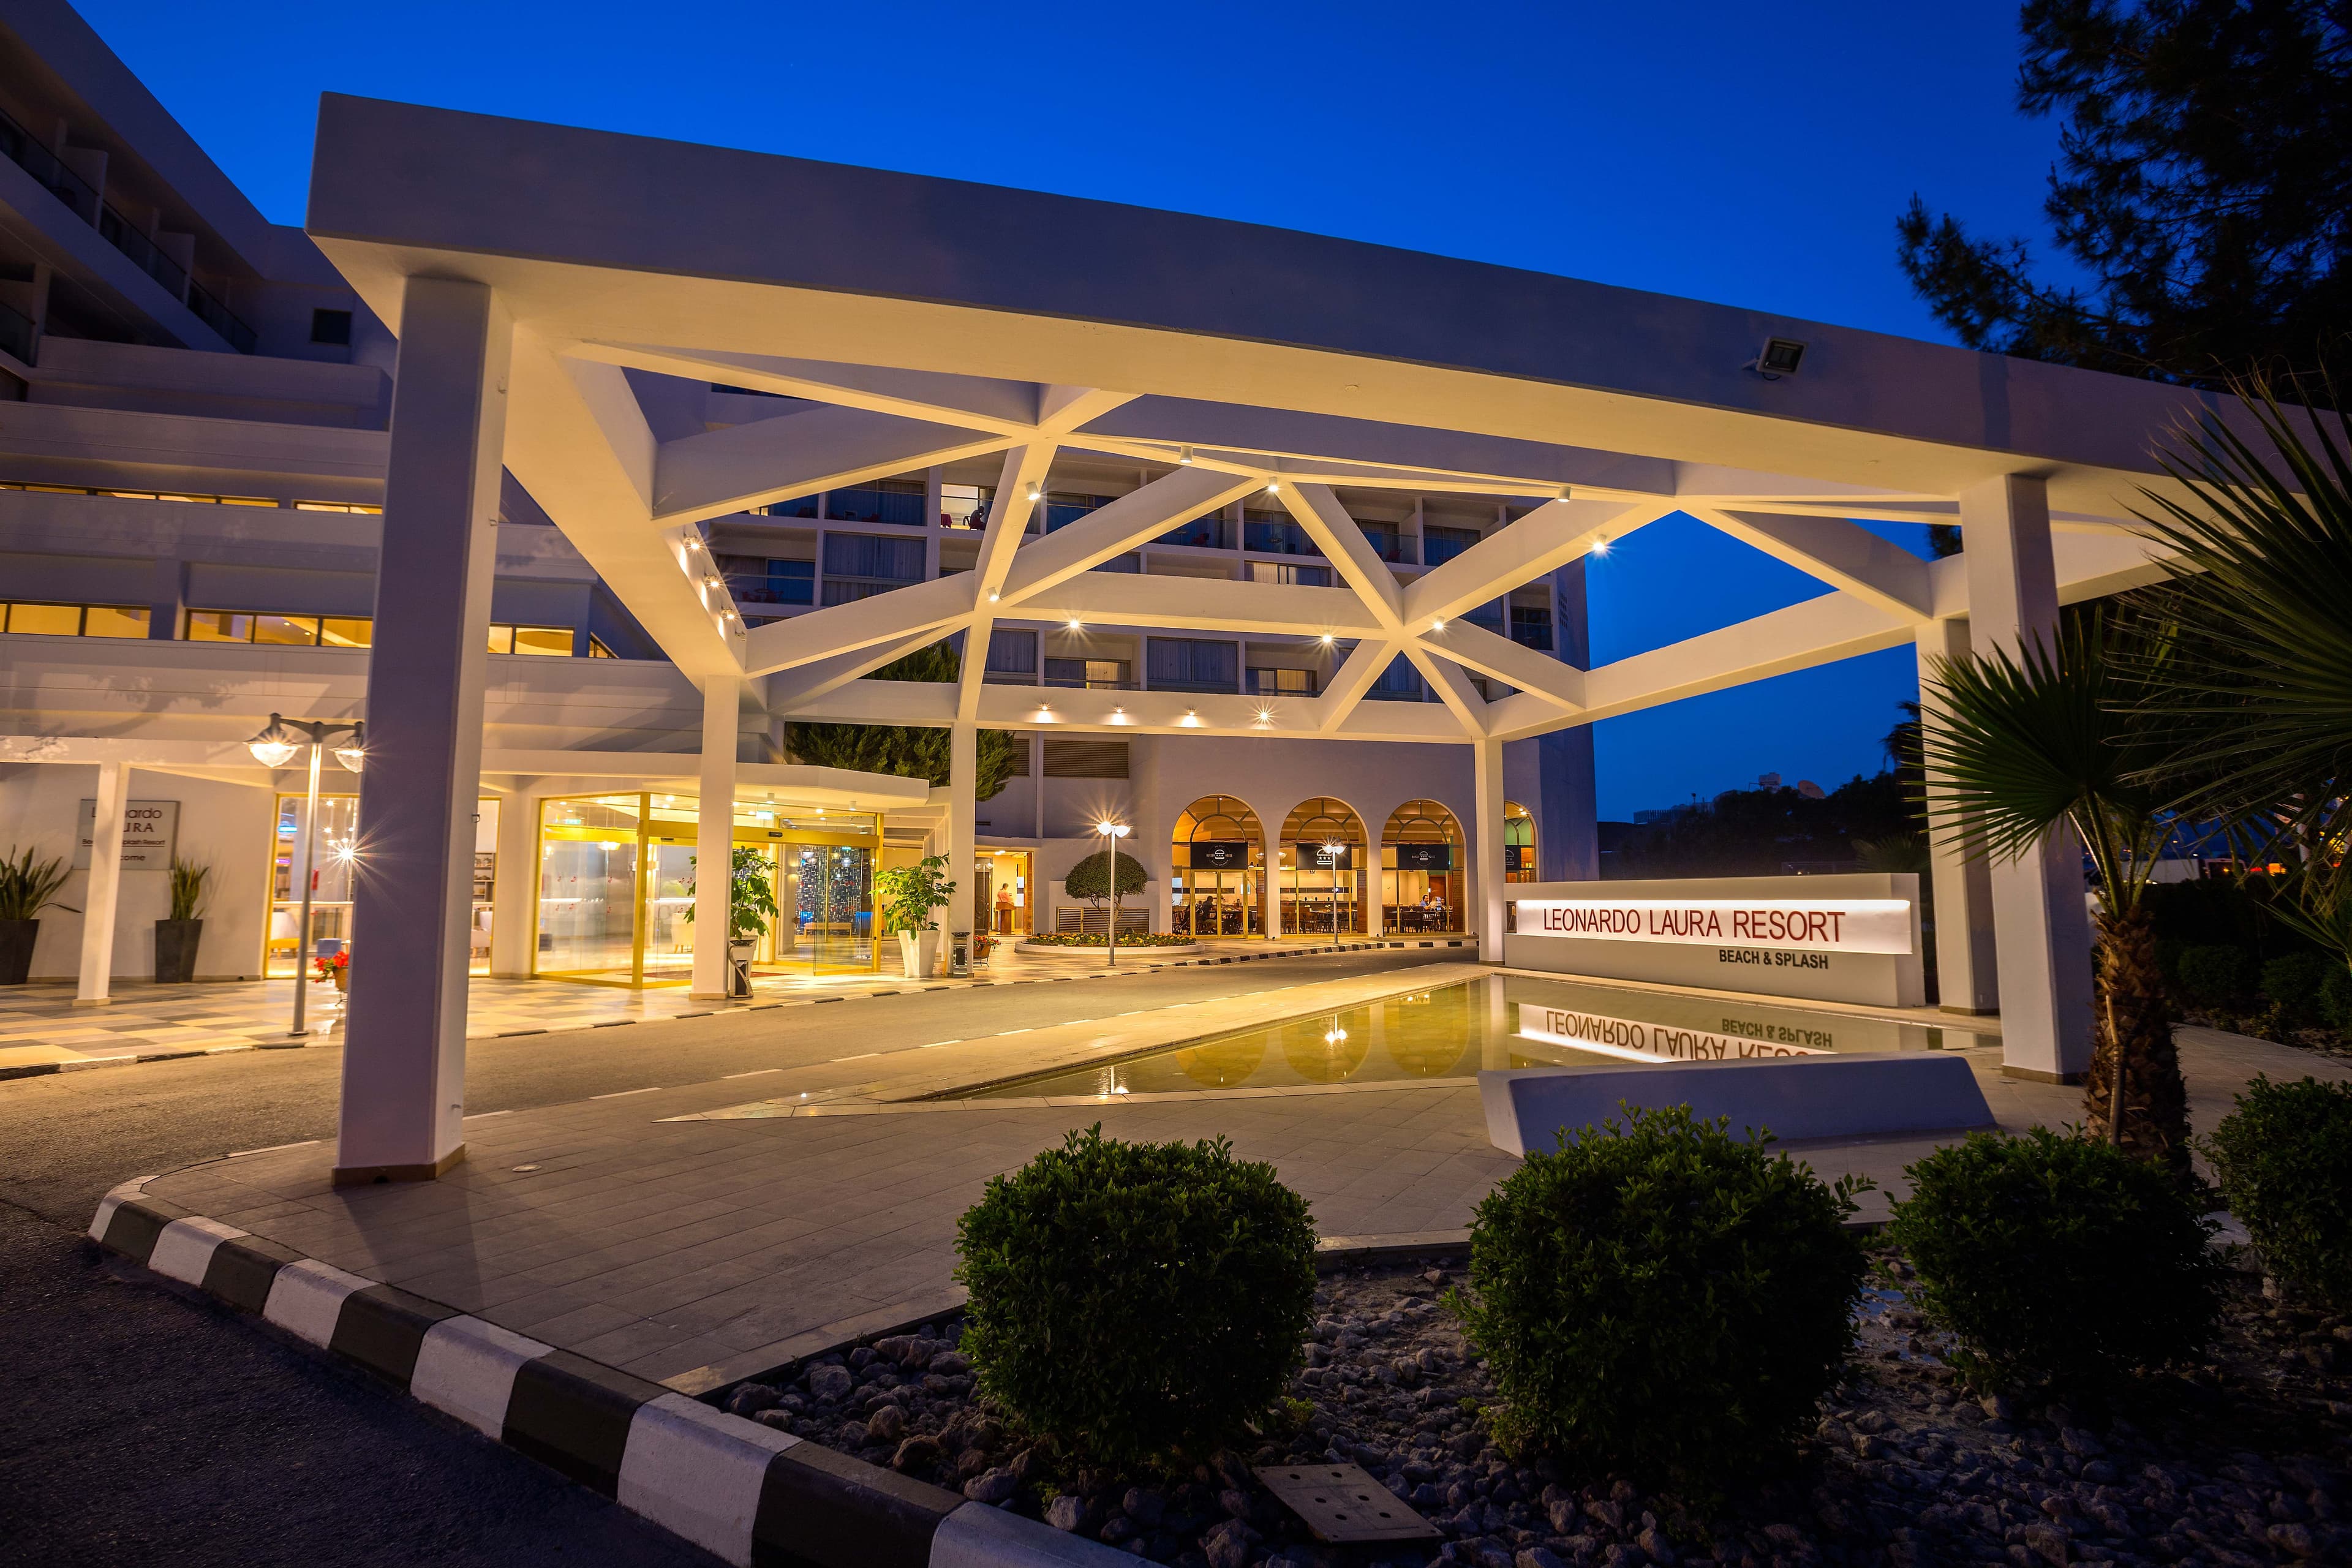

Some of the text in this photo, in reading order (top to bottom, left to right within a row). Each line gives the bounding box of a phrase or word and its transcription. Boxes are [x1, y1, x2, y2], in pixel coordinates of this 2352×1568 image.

[1544, 908, 1846, 942] LEONARDO LAURA RESORT
[1719, 949, 1828, 970] BEACH & SPLASH
